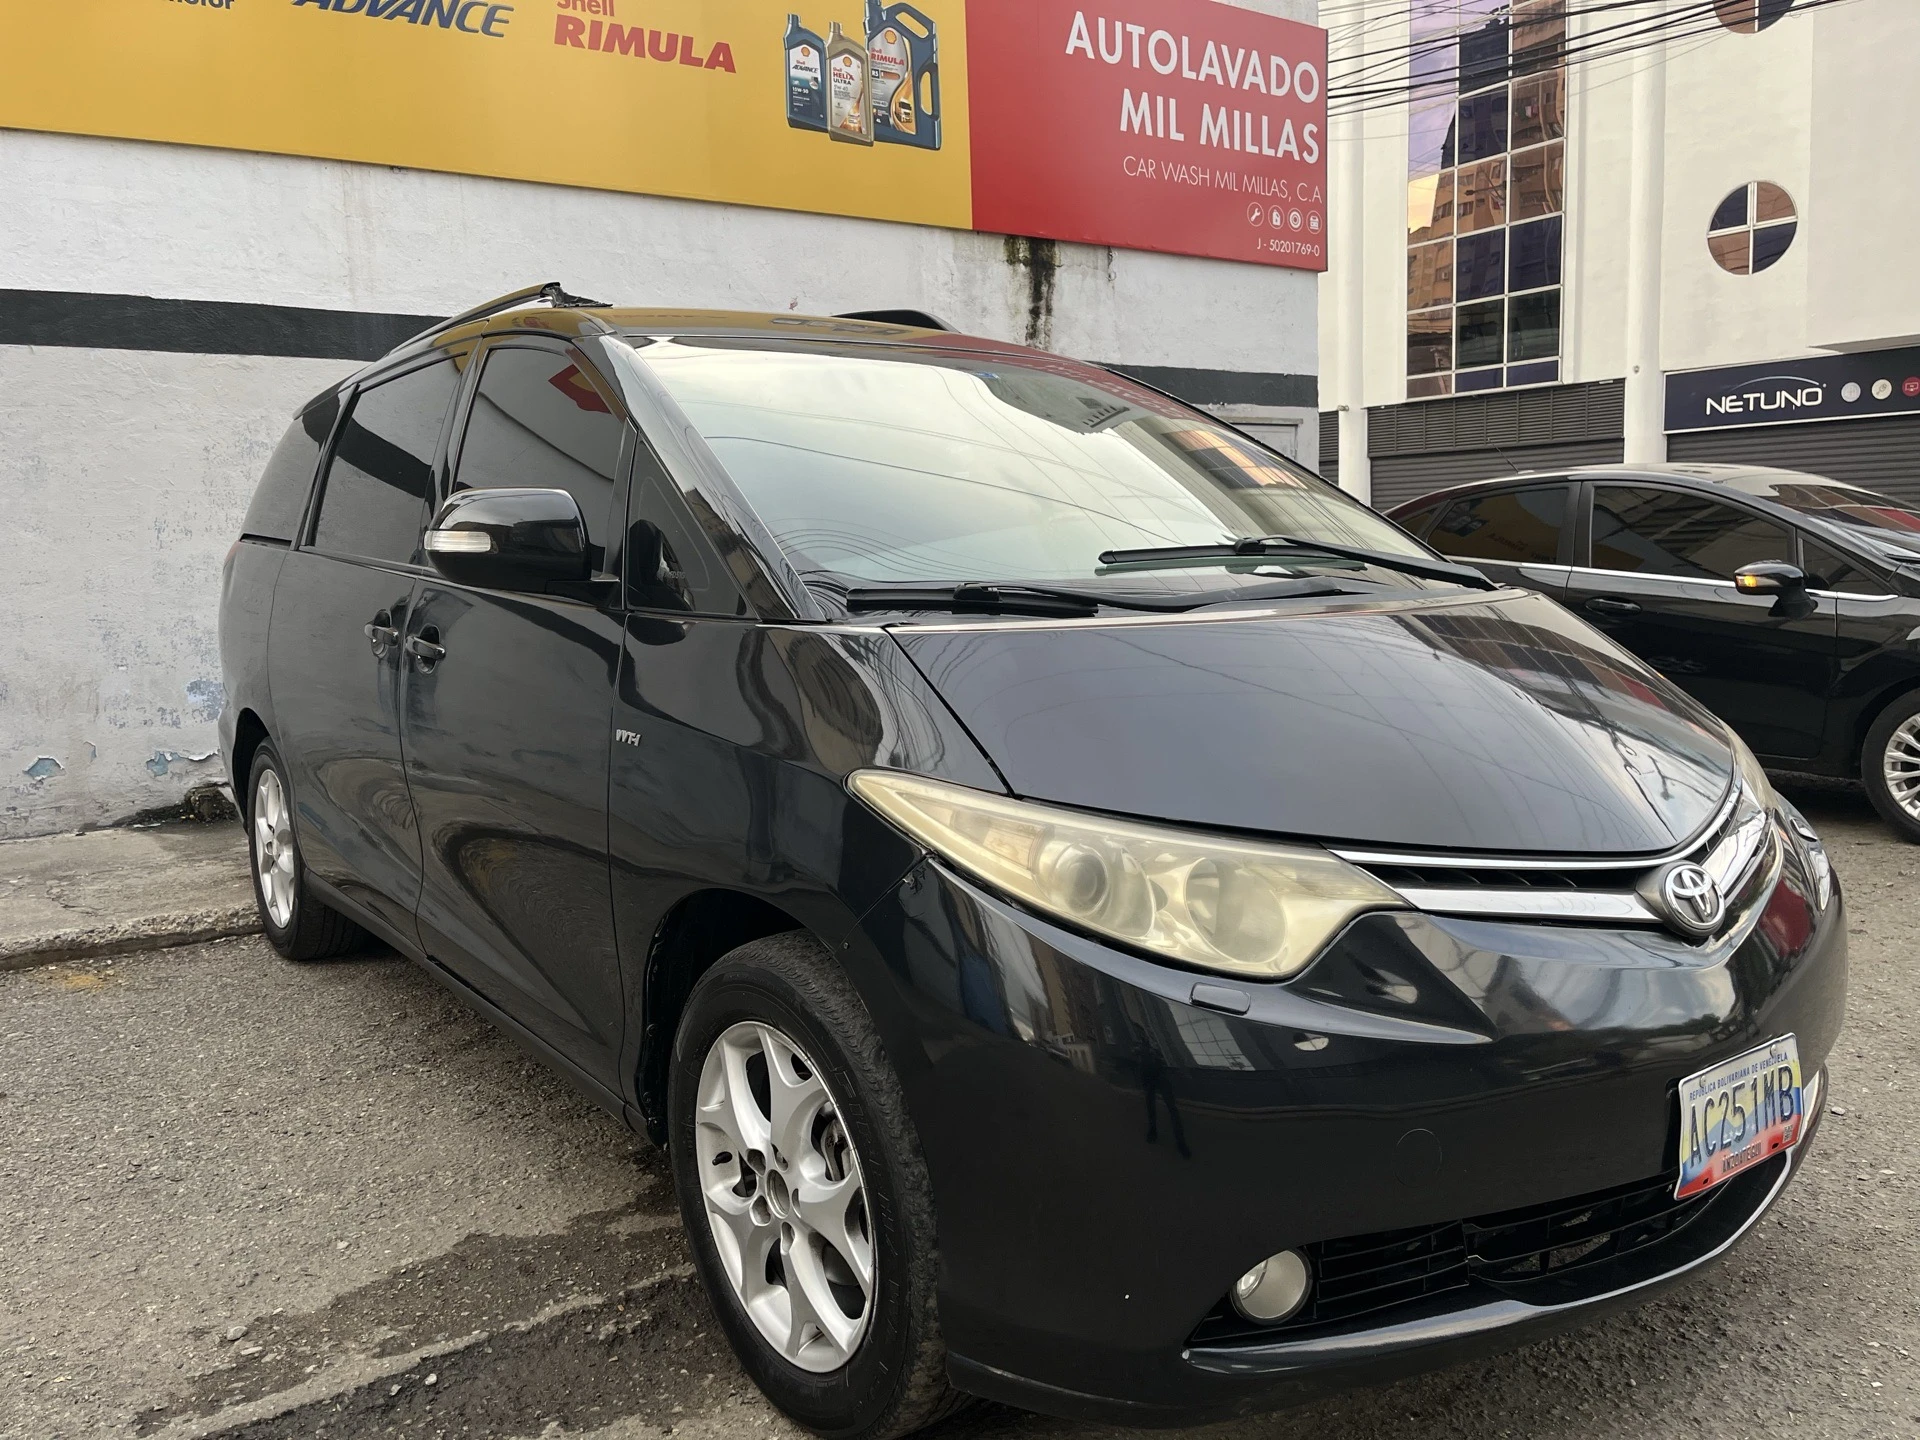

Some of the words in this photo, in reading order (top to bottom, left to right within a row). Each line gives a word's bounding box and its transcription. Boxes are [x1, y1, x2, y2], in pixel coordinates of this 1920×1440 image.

[292, 0, 514, 38] VANCE
[554, 14, 737, 74] RIMULA
[870, 53, 905, 66] RIMULA
[1065, 11, 1319, 103] AUTOLAVADO
[833, 71, 855, 81] HELIX
[833, 77, 852, 86] ULTRA
[1120, 88, 1184, 142] MIL
[1200, 103, 1319, 164] MILLAS
[1123, 156, 1156, 179] CAR
[1161, 161, 1210, 187] WASH
[1215, 170, 1238, 192] MIL
[1243, 174, 1292, 202] MILLAS,
[1297, 182, 1322, 203] C.A
[1269, 239, 1320, 257] 50201769-0
[1706, 387, 1823, 415] NETUNO
[1717, 1066, 1750, 1088] BOLIVARIANA
[1751, 1063, 1758, 1074] DE
[1760, 1051, 1788, 1070] VENEZUELA
[1690, 1064, 1794, 1169] AC251MB
